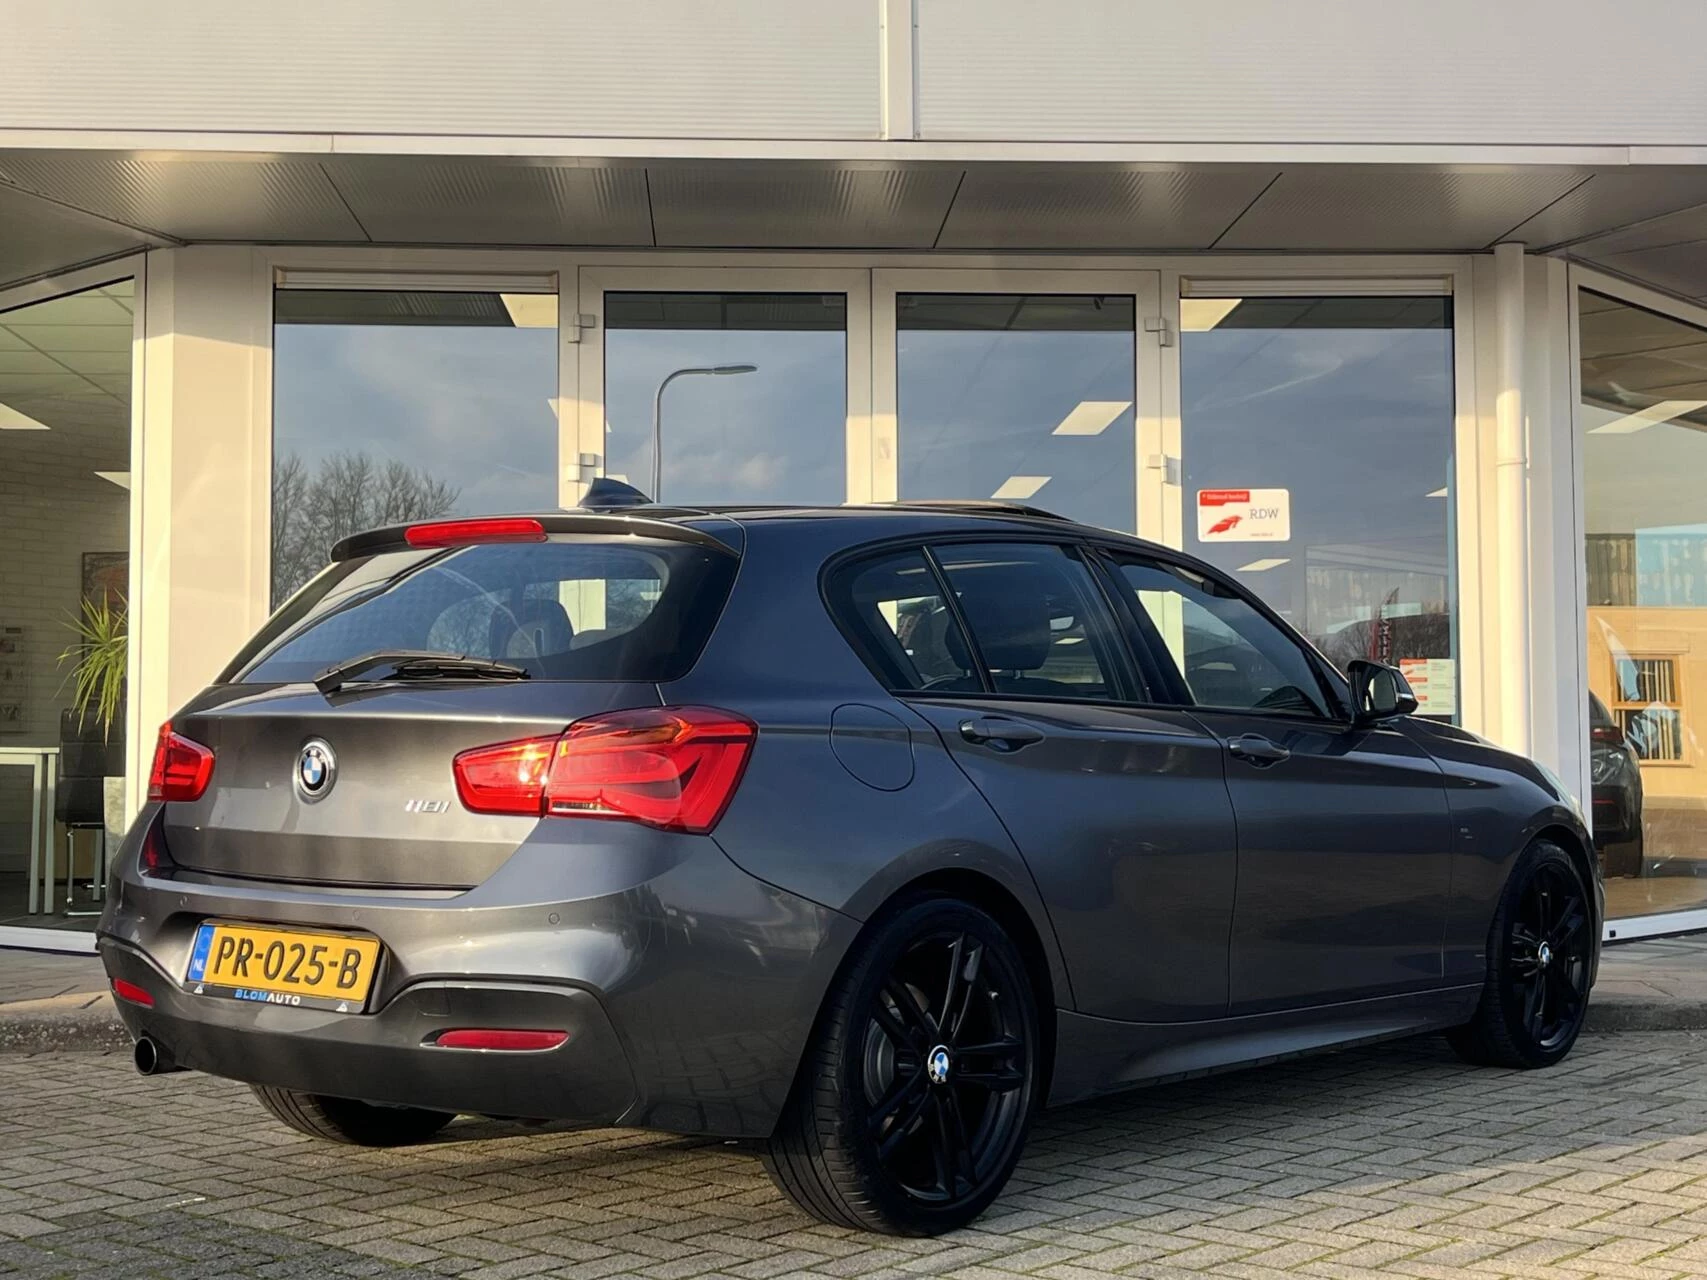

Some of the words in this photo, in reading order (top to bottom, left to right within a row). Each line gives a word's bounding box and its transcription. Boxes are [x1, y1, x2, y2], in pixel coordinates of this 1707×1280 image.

[1249, 508, 1279, 519] RDW
[193, 959, 204, 971] NL
[213, 936, 361, 989] PR-025-B
[234, 989, 301, 1005] BLOMAUTO
